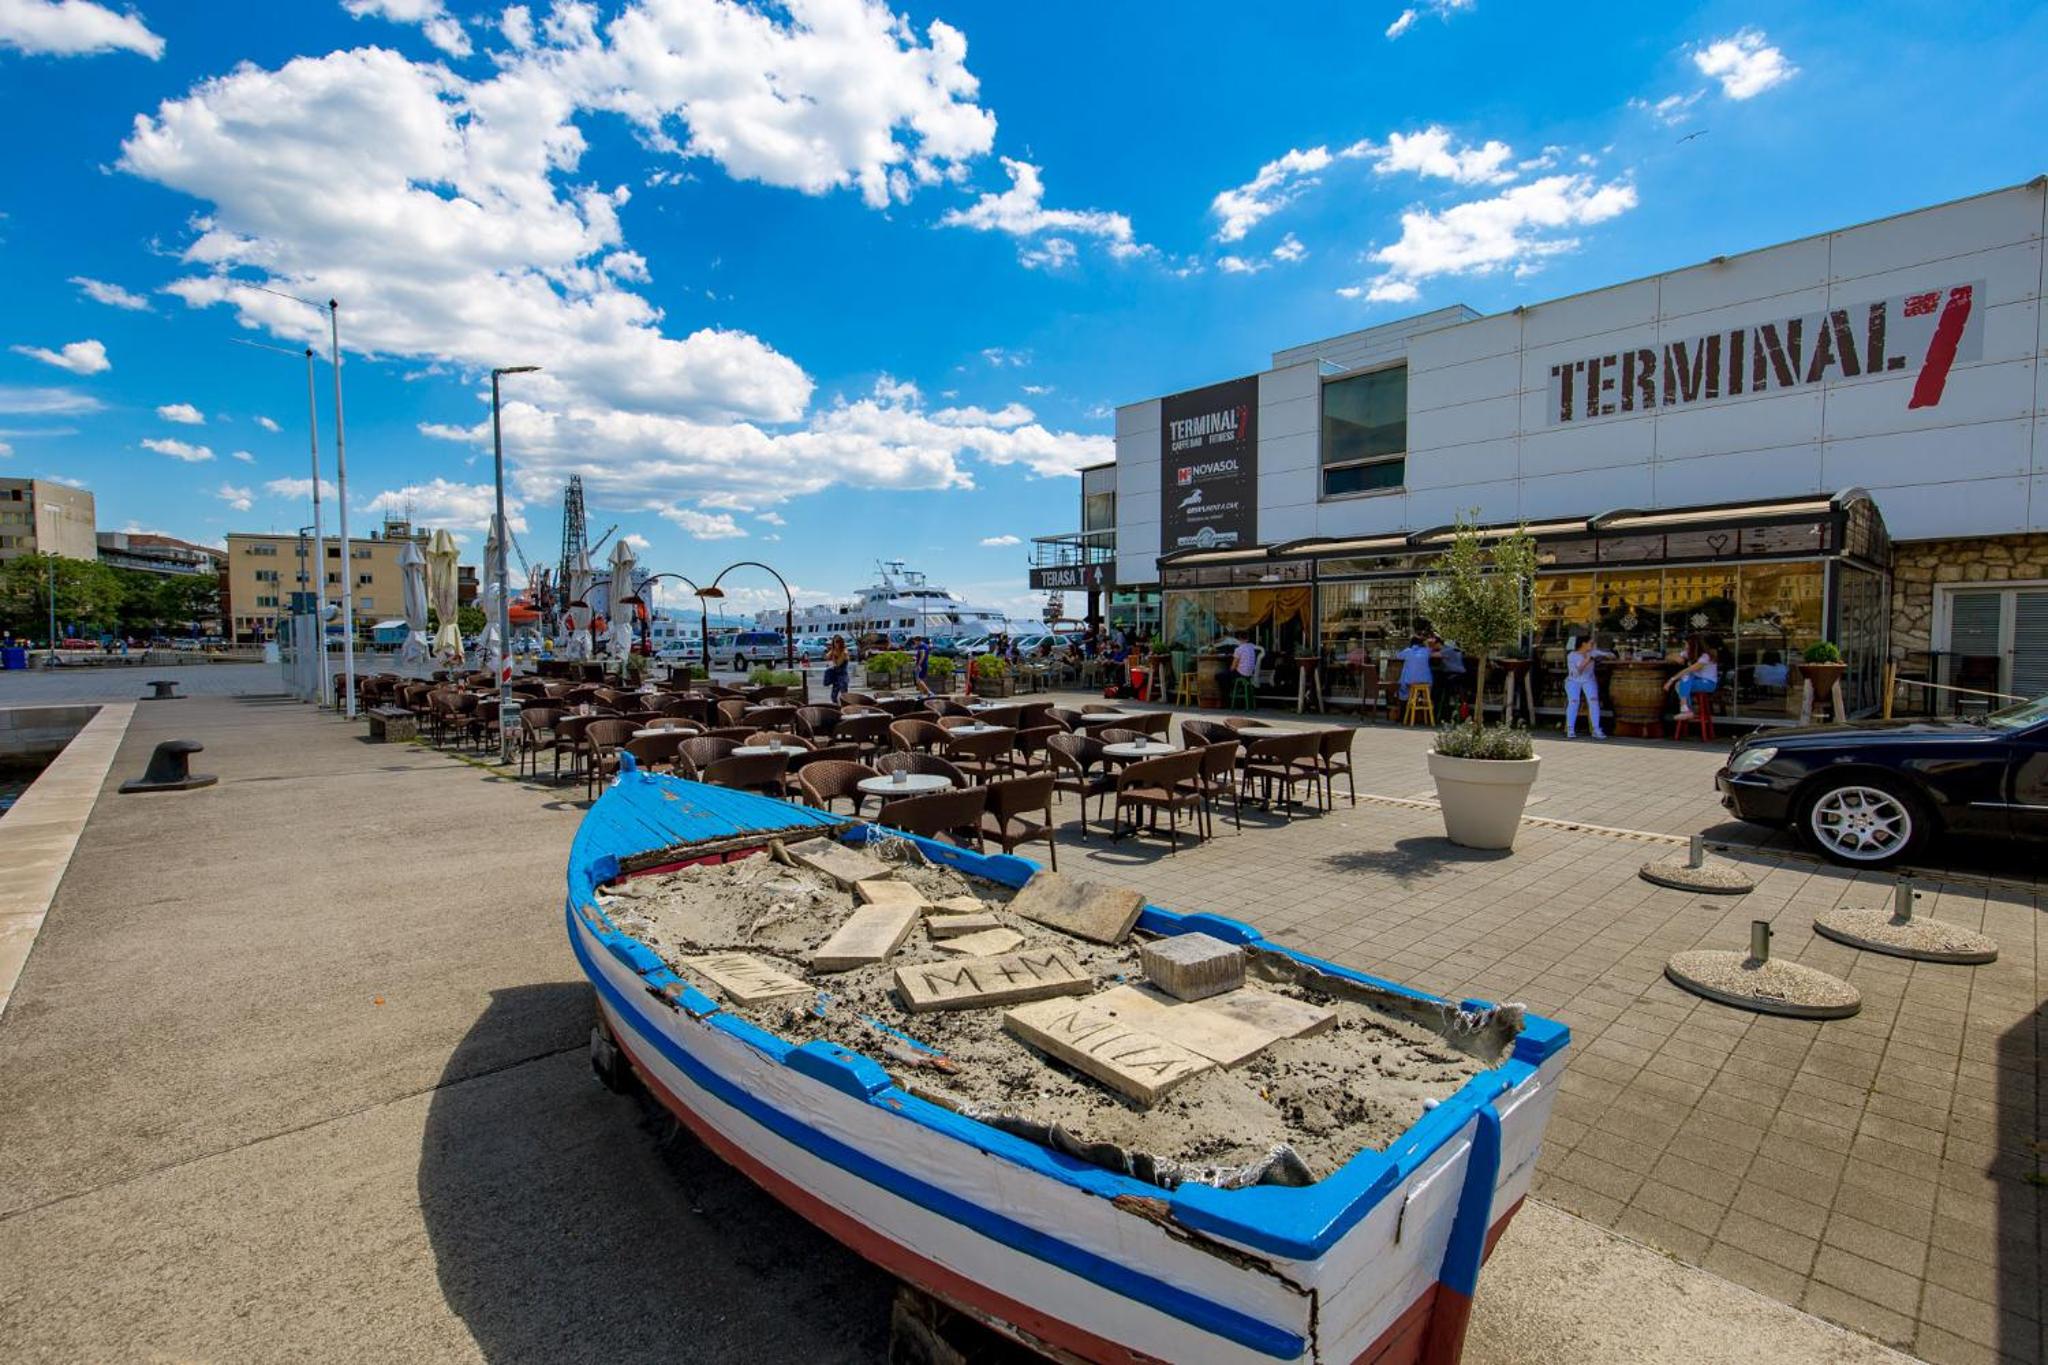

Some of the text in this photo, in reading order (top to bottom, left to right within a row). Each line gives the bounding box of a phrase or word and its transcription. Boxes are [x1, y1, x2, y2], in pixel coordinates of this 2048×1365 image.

[1552, 285, 1974, 421] TERMINAL 7
[1170, 409, 1237, 442] TERMINAL
[1192, 459, 1239, 475] NOVASOL
[1041, 570, 1076, 587] TERASA
